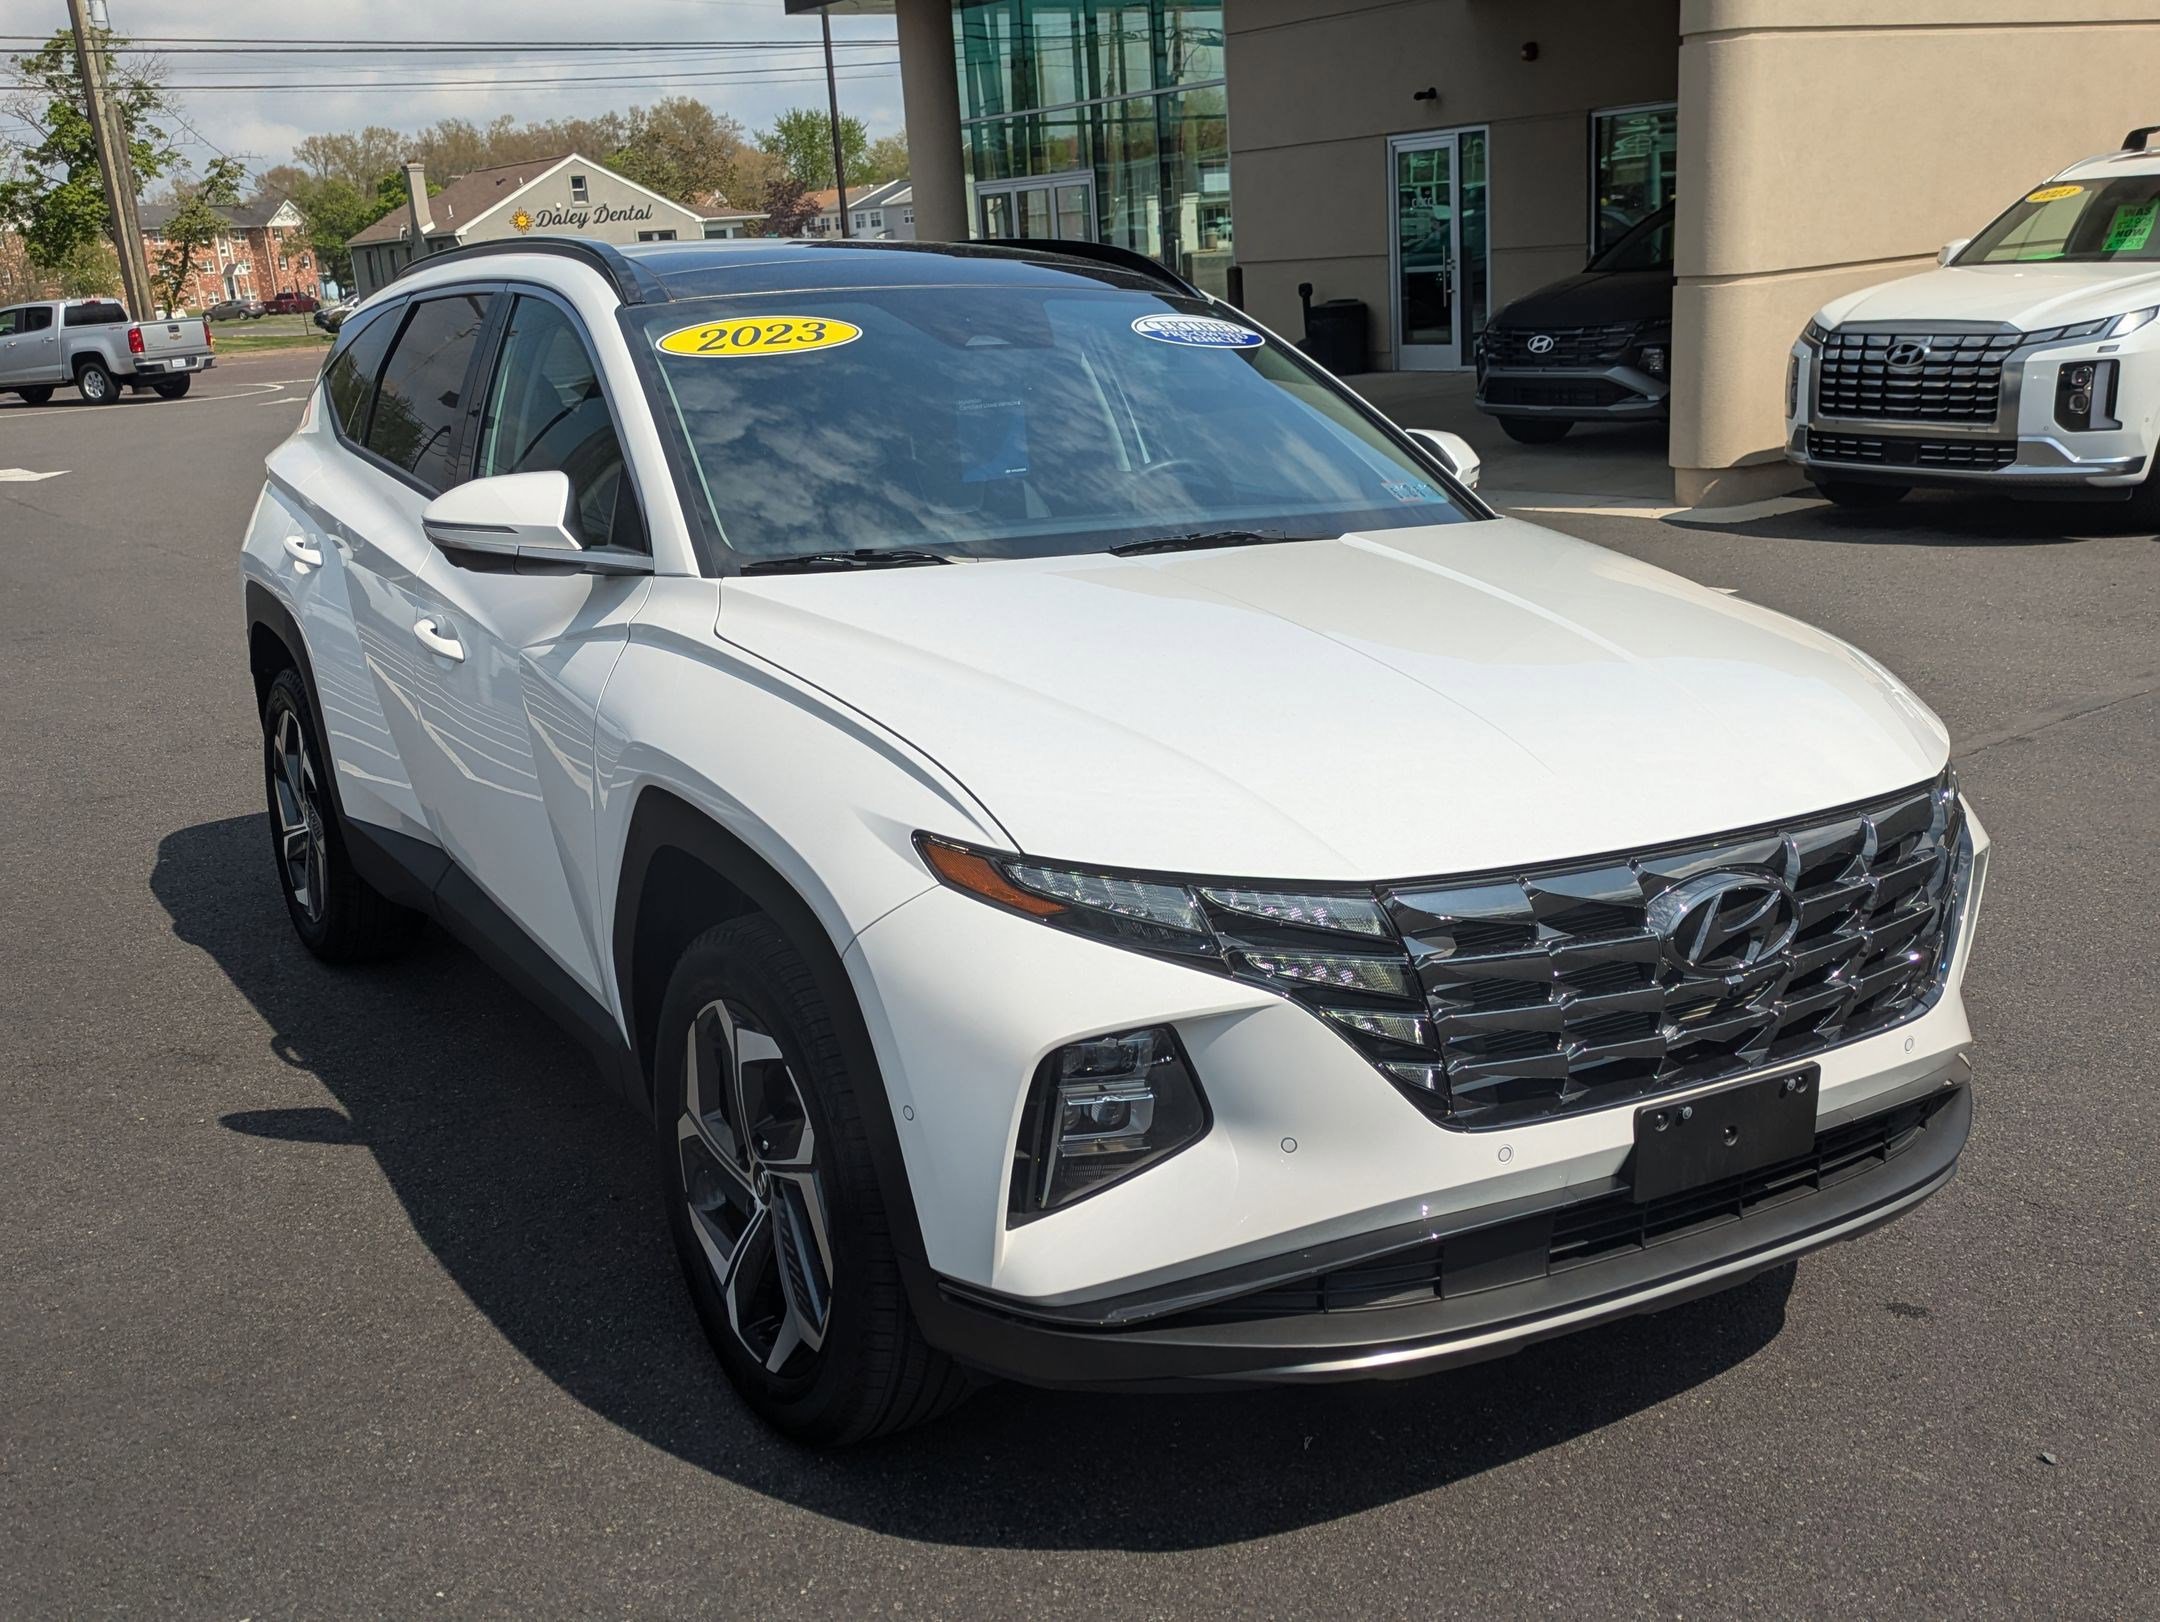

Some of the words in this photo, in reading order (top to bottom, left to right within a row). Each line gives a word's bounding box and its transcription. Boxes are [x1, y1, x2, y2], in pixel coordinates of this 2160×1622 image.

[536, 208, 590, 229] Daley
[593, 203, 653, 224] Dental
[696, 322, 827, 352] 2023
[1143, 320, 1244, 334] CERTIFIED
